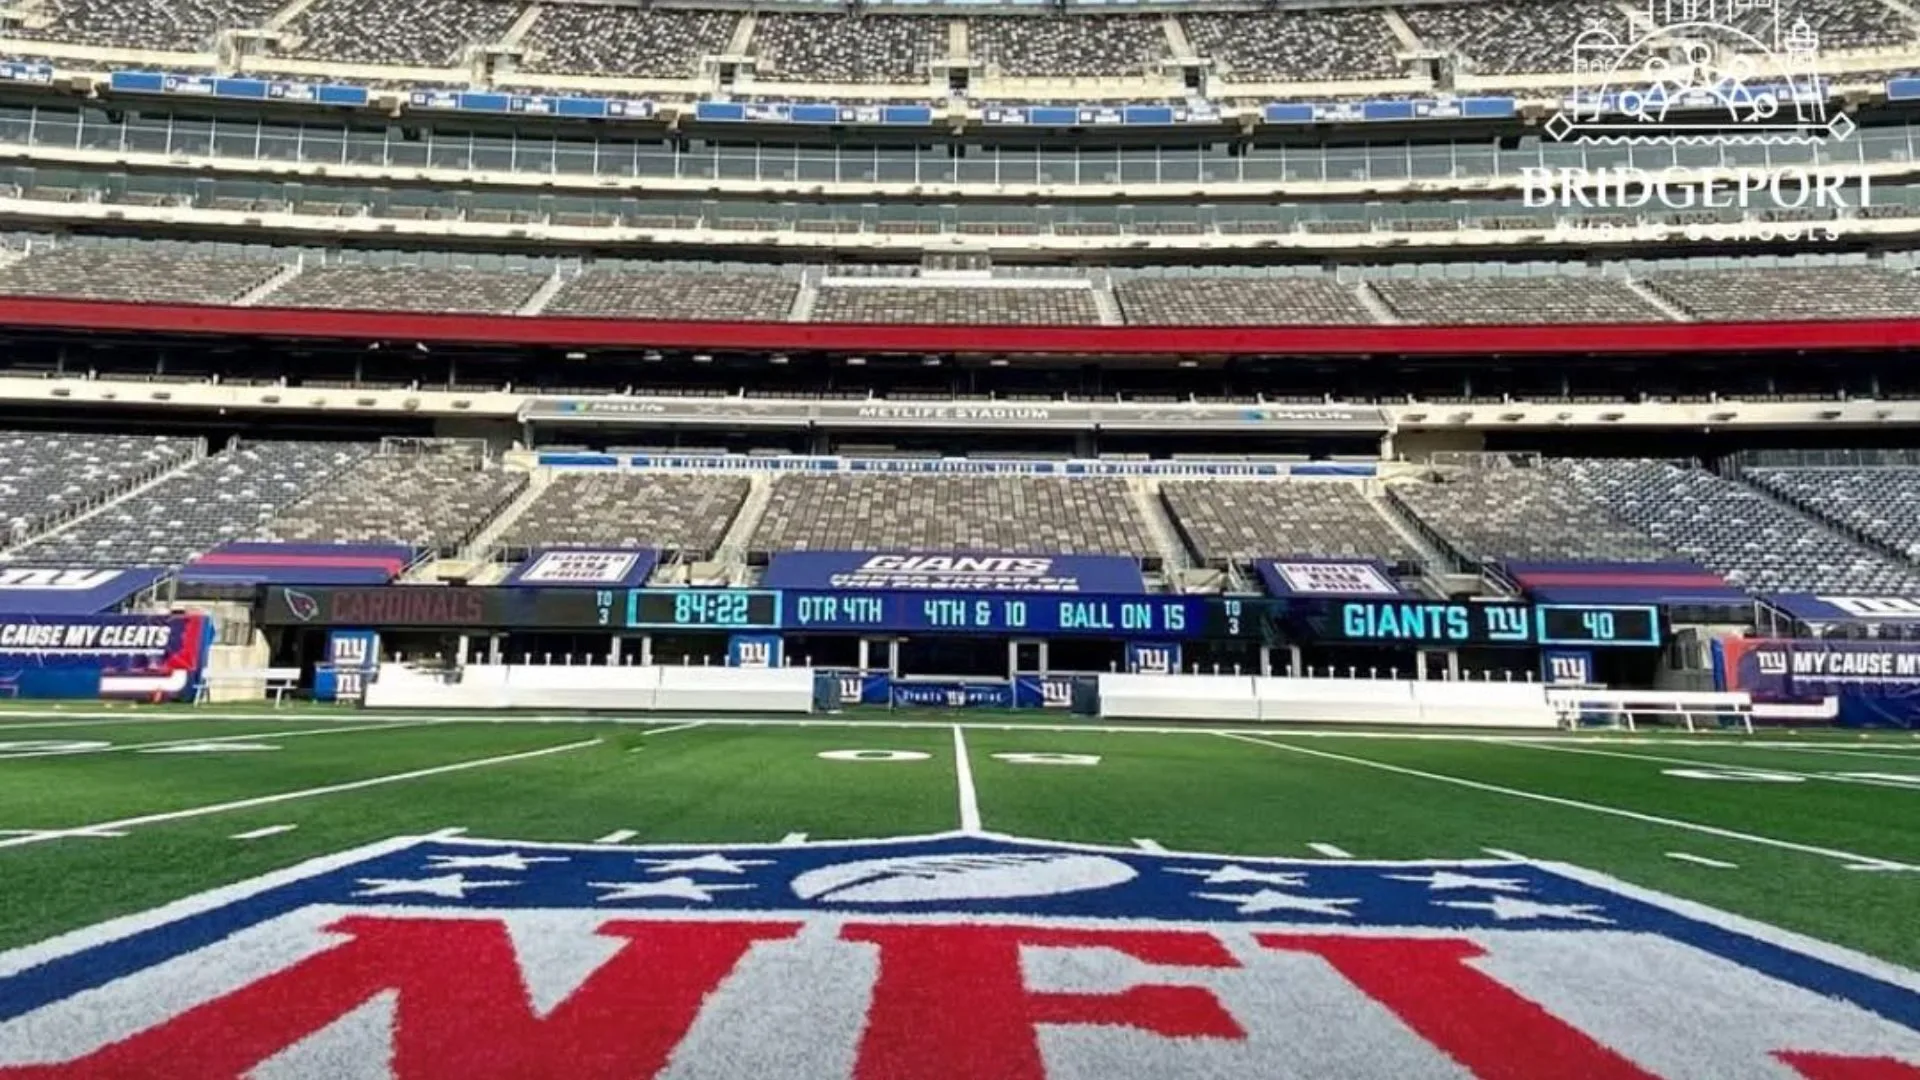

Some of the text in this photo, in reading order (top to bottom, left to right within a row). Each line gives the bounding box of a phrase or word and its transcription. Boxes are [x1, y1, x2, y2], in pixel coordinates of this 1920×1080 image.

[859, 407, 1049, 419] METLIFE STADIUM
[861, 555, 1052, 572] GIANTS
[332, 591, 482, 622] CARDINALS
[599, 608, 609, 624] 3
[675, 594, 747, 623] 84:22
[798, 597, 1185, 630] QTR 4TH 4TH & 10 BALL ON 15
[1228, 618, 1240, 634] 3
[1343, 604, 1469, 639] GIANTS
[1582, 612, 1615, 639] 40
[1, 623, 171, 647] CAUSE MY CLEATS
[1793, 652, 1826, 673] MY
[1829, 652, 1893, 674] CAUSE
[0, 915, 1920, 1080] NFL
